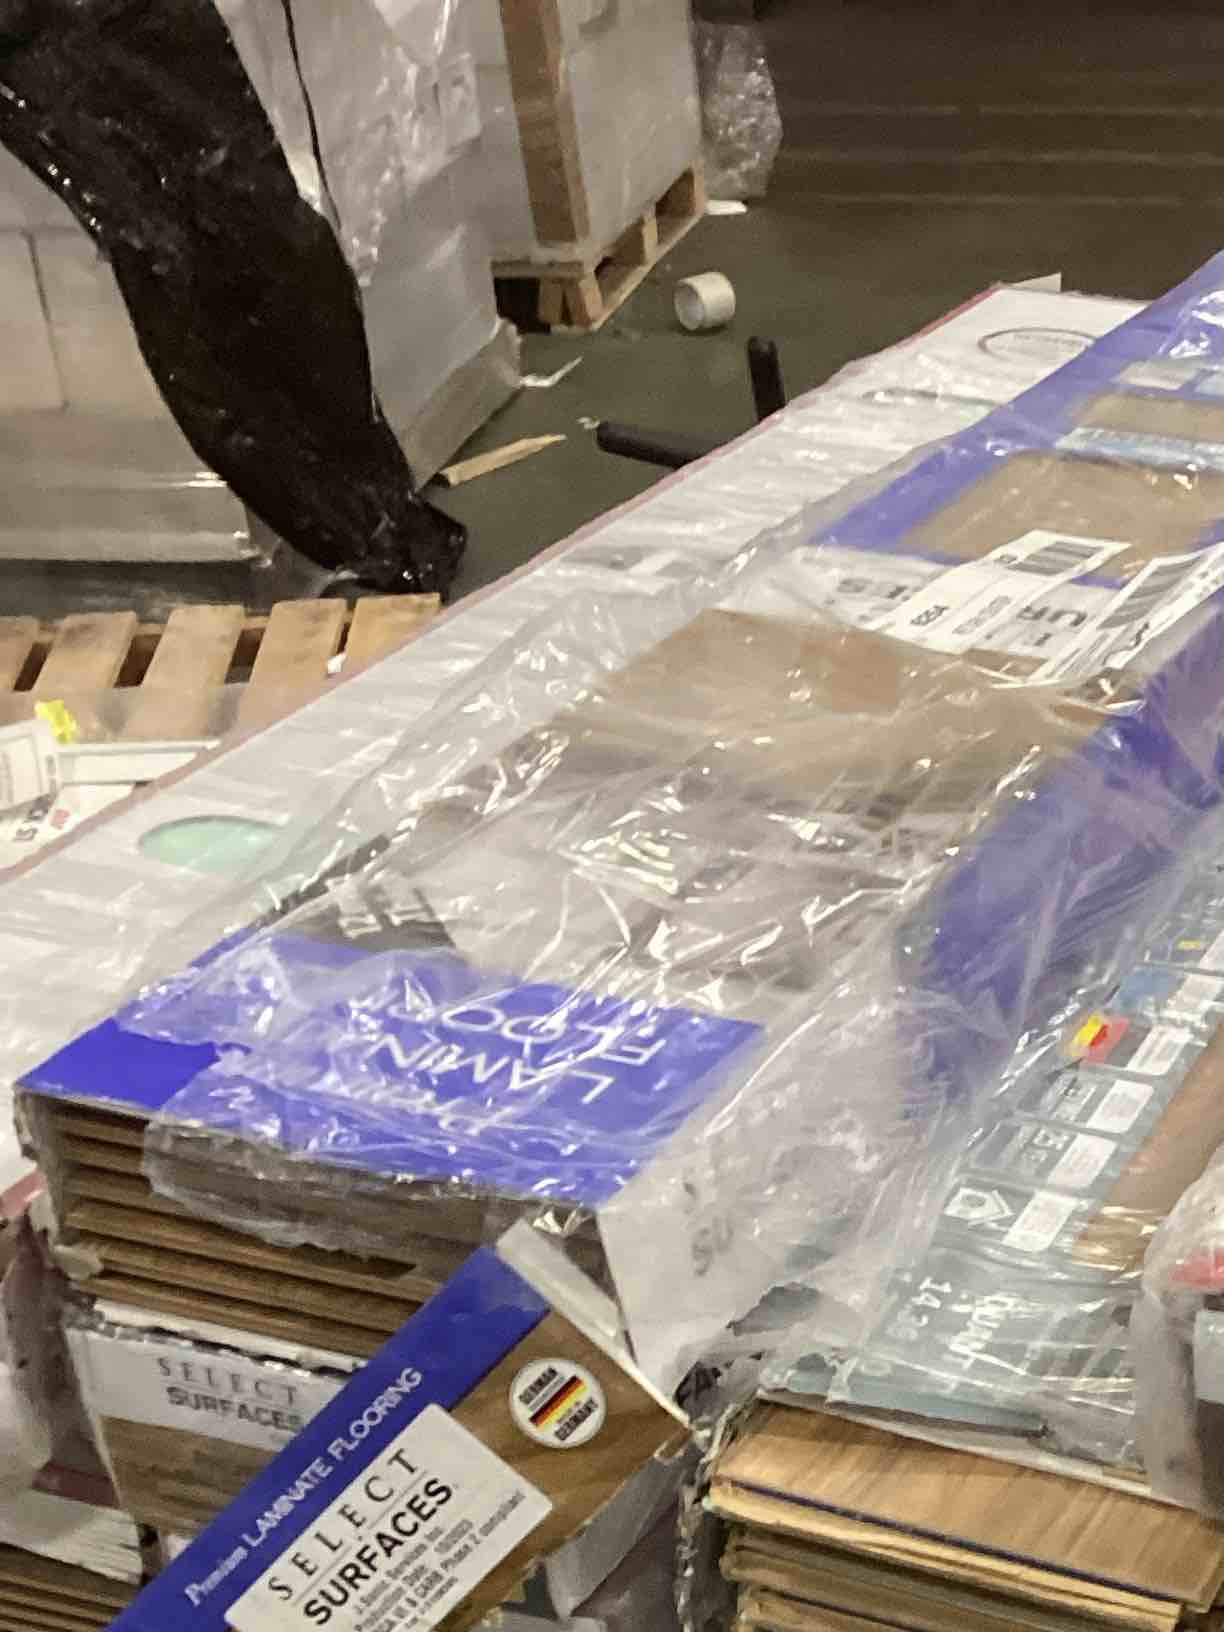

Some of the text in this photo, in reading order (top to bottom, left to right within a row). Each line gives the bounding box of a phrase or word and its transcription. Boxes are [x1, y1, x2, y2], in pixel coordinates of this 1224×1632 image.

[158, 1356, 297, 1404] SELECT
[242, 1456, 334, 1547] LAMINATE
[327, 1367, 424, 1462] FLOORING
[268, 1447, 418, 1601] SELECT
[303, 1478, 453, 1626] SURFACES
